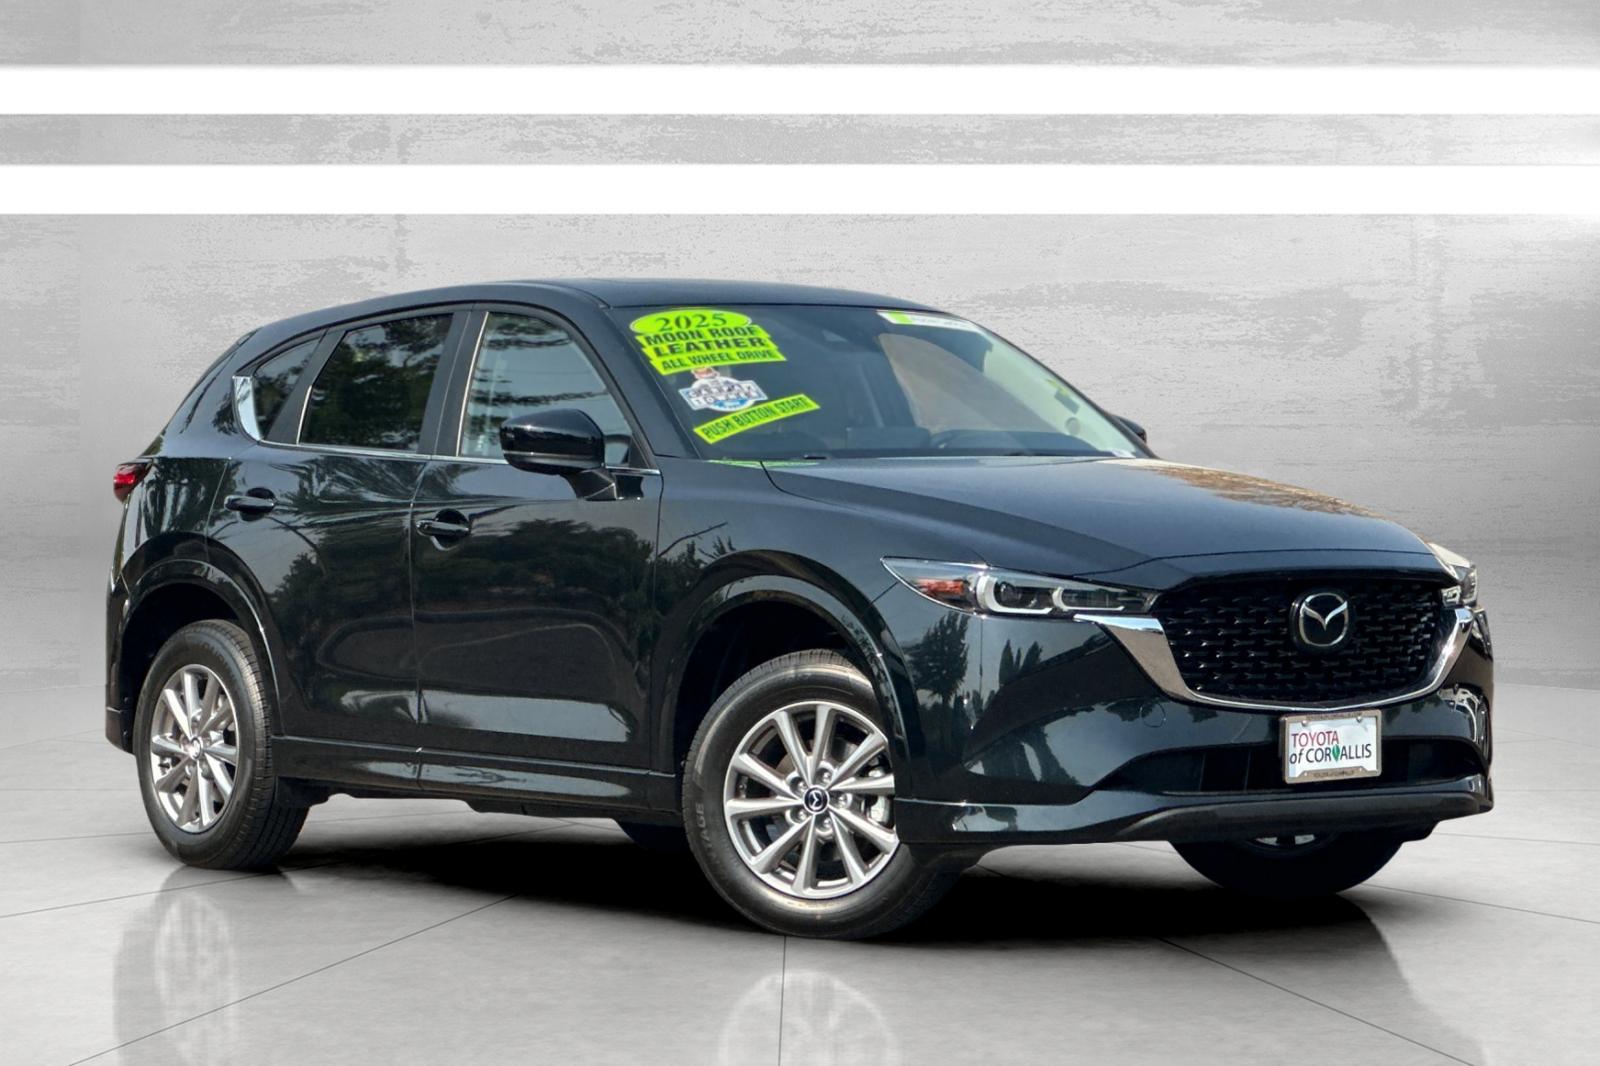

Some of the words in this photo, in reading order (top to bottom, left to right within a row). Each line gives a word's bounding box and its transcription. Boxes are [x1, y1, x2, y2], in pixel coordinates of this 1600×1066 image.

[655, 313, 727, 332] 2025
[644, 329, 703, 346] MOON
[708, 325, 757, 338] ROOF
[653, 337, 766, 357] LEATHER
[661, 359, 688, 371] ALL
[687, 352, 732, 365] WHEEL
[736, 349, 774, 360] DRIVE
[701, 419, 736, 440] PUSH
[731, 406, 781, 427] BUTTON
[774, 397, 811, 413] START
[1291, 730, 1340, 748] TOYOTA
[1289, 748, 1305, 765] of
